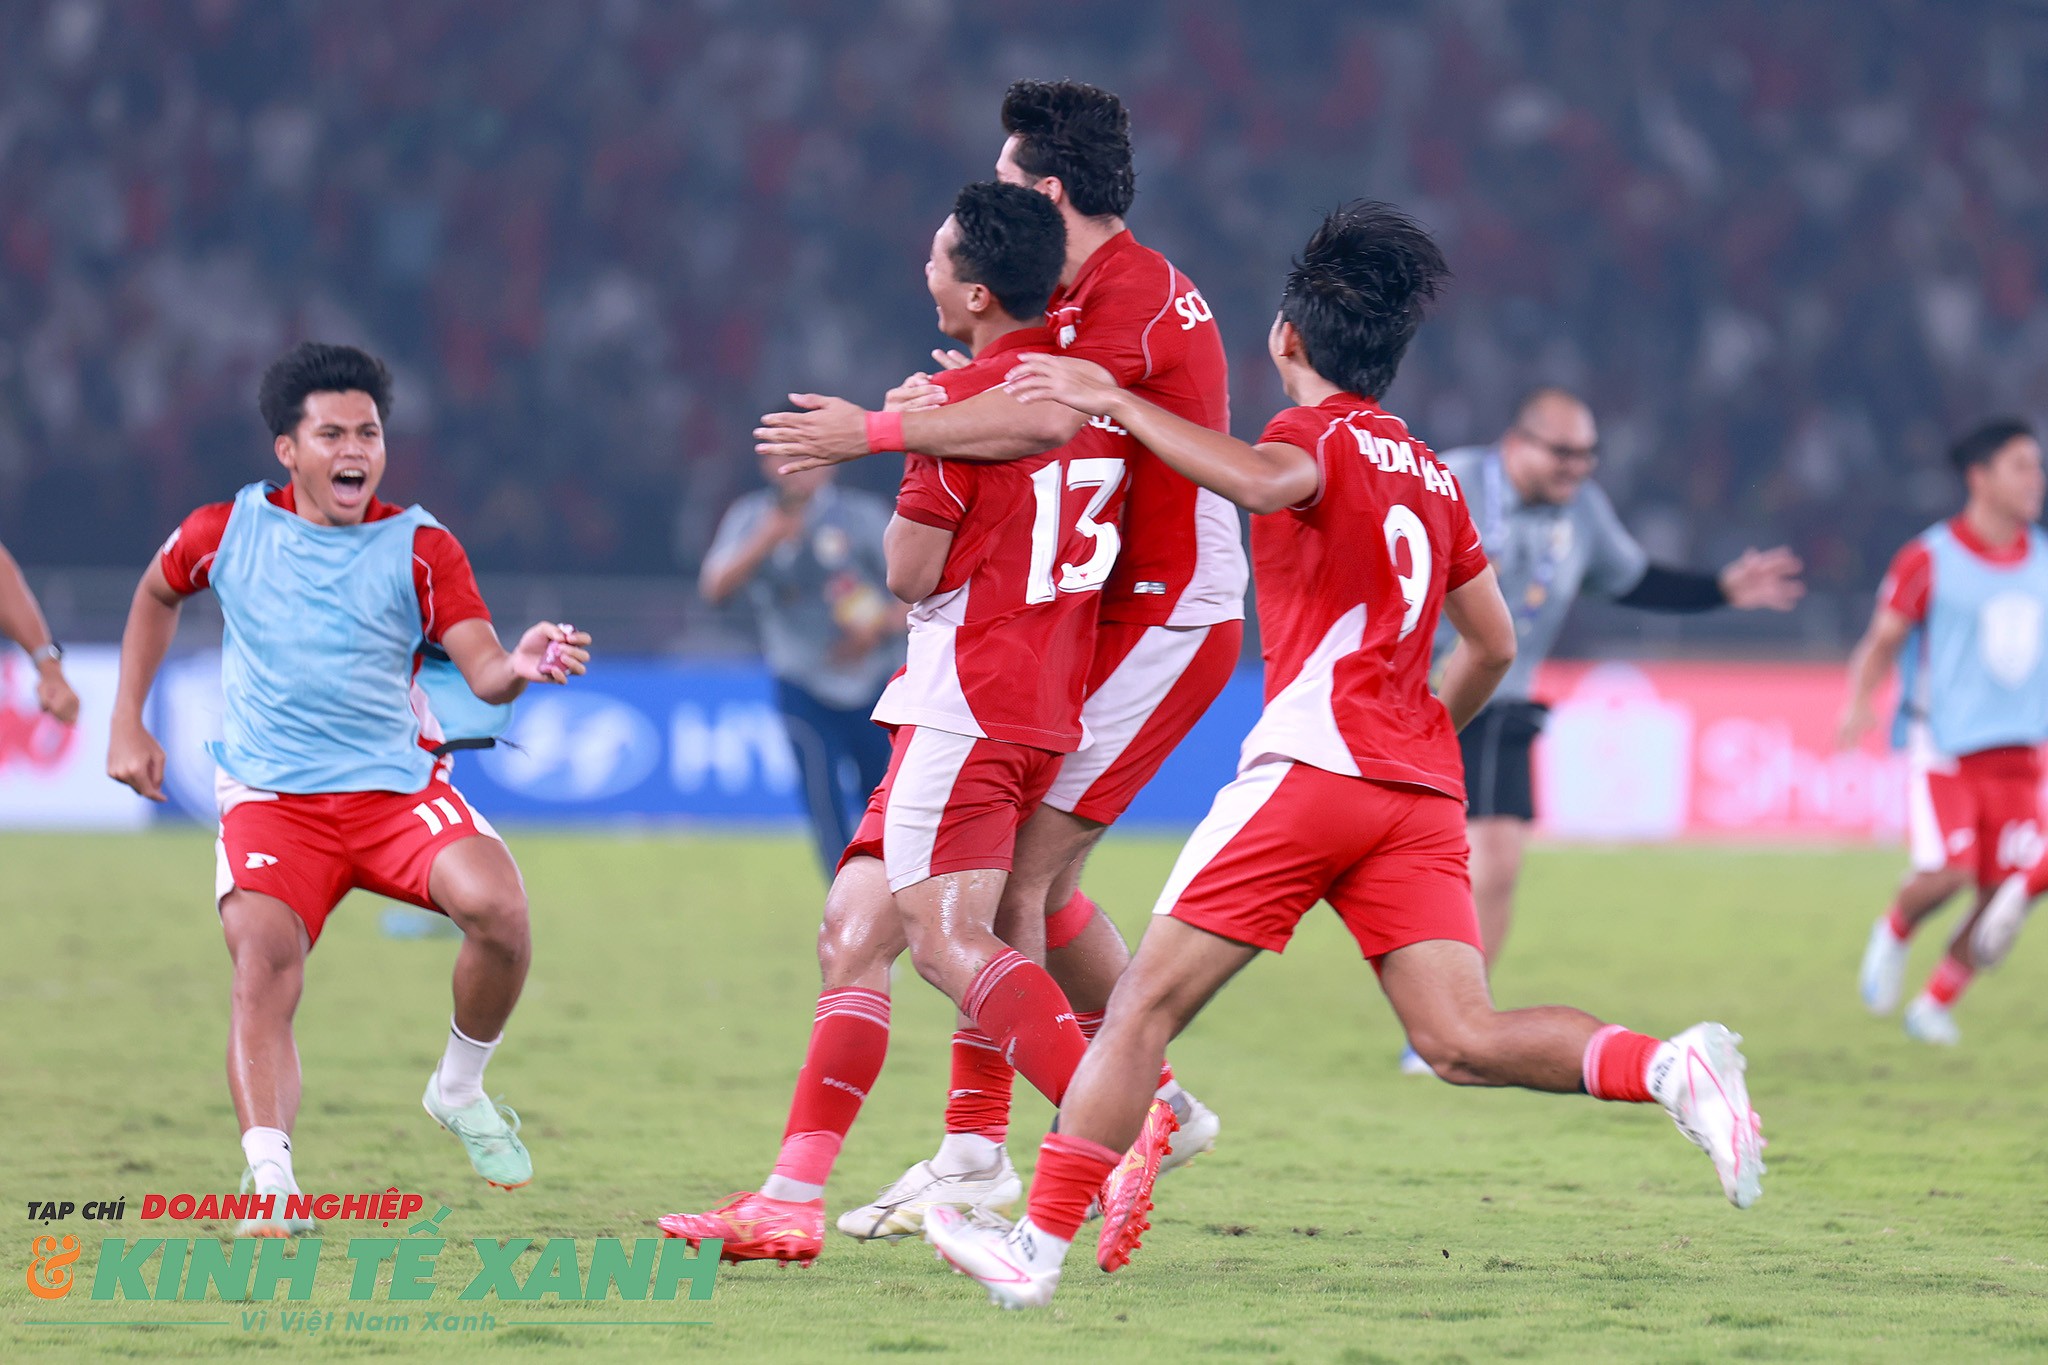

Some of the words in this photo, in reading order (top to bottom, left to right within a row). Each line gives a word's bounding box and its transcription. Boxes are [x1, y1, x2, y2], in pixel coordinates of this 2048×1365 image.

[1025, 457, 1126, 605] 13
[1382, 504, 1433, 643] 9
[411, 796, 463, 836] 11
